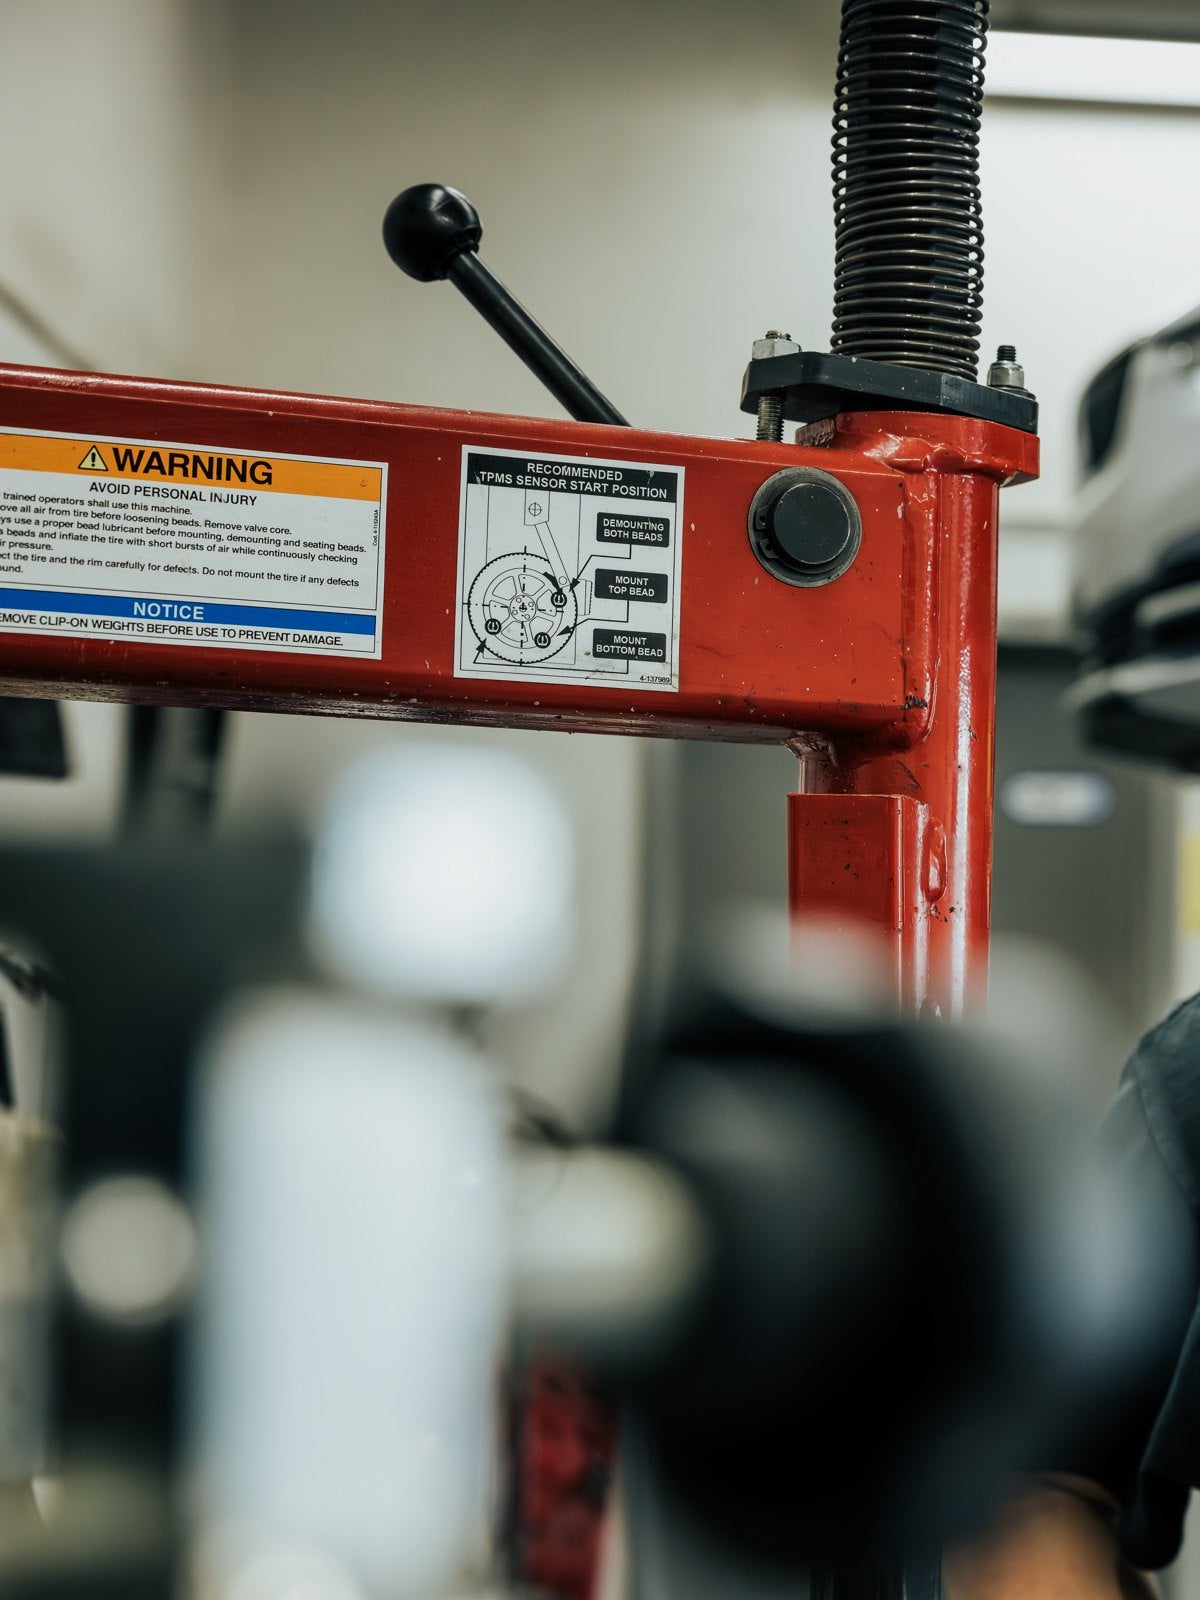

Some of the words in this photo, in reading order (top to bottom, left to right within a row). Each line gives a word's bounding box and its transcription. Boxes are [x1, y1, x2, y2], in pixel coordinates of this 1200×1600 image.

[112, 447, 273, 485] WARNING
[527, 462, 623, 481] RECOMMENDED
[89, 482, 130, 495] AVOID
[134, 486, 206, 502] PERSONAL
[210, 492, 257, 506] INJURY
[479, 471, 513, 484] TPMS
[516, 475, 566, 490] SENSOR
[570, 481, 608, 493] START
[612, 485, 667, 499] POSITION
[3, 492, 36, 501] trained
[38, 495, 85, 506] operators
[88, 499, 109, 508] shall
[131, 503, 149, 511] this
[151, 505, 192, 515] machine.
[20, 505, 31, 513] all
[34, 506, 45, 514] air
[48, 507, 70, 516] from
[73, 509, 88, 518] tire
[91, 510, 121, 520] before
[123, 514, 169, 526] loosening
[204, 520, 242, 531] Remove
[244, 524, 268, 533] valve
[270, 527, 292, 535] core.
[603, 518, 664, 531] DEMOUNTING
[8, 540, 53, 551] pressure.
[42, 520, 74, 529] proper
[77, 521, 100, 530] bead
[102, 522, 143, 534] lubricant
[146, 527, 175, 536] before
[226, 534, 281, 547] demounting
[283, 538, 300, 547] and
[303, 541, 335, 552] seating
[337, 543, 366, 552] beads.
[603, 529, 629, 539] BOTH
[632, 531, 663, 542] BEADS
[6, 528, 36, 538] beads
[38, 531, 57, 539] and
[91, 535, 106, 543] the
[108, 536, 123, 544] tire
[126, 538, 146, 546] with
[148, 539, 172, 549] short
[175, 541, 204, 551] bursts
[206, 544, 217, 552] of
[218, 545, 230, 553] air
[232, 546, 256, 555] while
[257, 548, 315, 561] continuously
[318, 553, 358, 565] checking
[13, 552, 29, 561] the
[31, 554, 46, 562] tire
[49, 556, 67, 564] and
[69, 557, 85, 565] the
[87, 558, 103, 567] rim
[105, 560, 145, 571] carefully
[148, 562, 161, 571] for
[202, 567, 215, 575] Do
[217, 568, 233, 577] not
[235, 571, 265, 579] mount
[267, 572, 281, 580] the
[283, 573, 298, 582] tire
[300, 575, 306, 583] if
[308, 576, 325, 586] any
[327, 577, 360, 587] defects
[608, 585, 627, 595] TOP
[629, 587, 655, 597] BEAD
[615, 575, 649, 586] MOUNT
[133, 601, 204, 620] NOTICE
[39, 615, 88, 628] CLIP-ON
[91, 619, 144, 633] WEIGHTS
[146, 623, 193, 636] BEFORE
[196, 627, 218, 637] USE
[221, 629, 236, 639] TO
[238, 630, 291, 642] PREVENT
[292, 633, 344, 646] DAMAGE.
[613, 635, 647, 646] MOUNT
[596, 644, 636, 655] BOTTOM
[638, 647, 663, 657] BEAD
